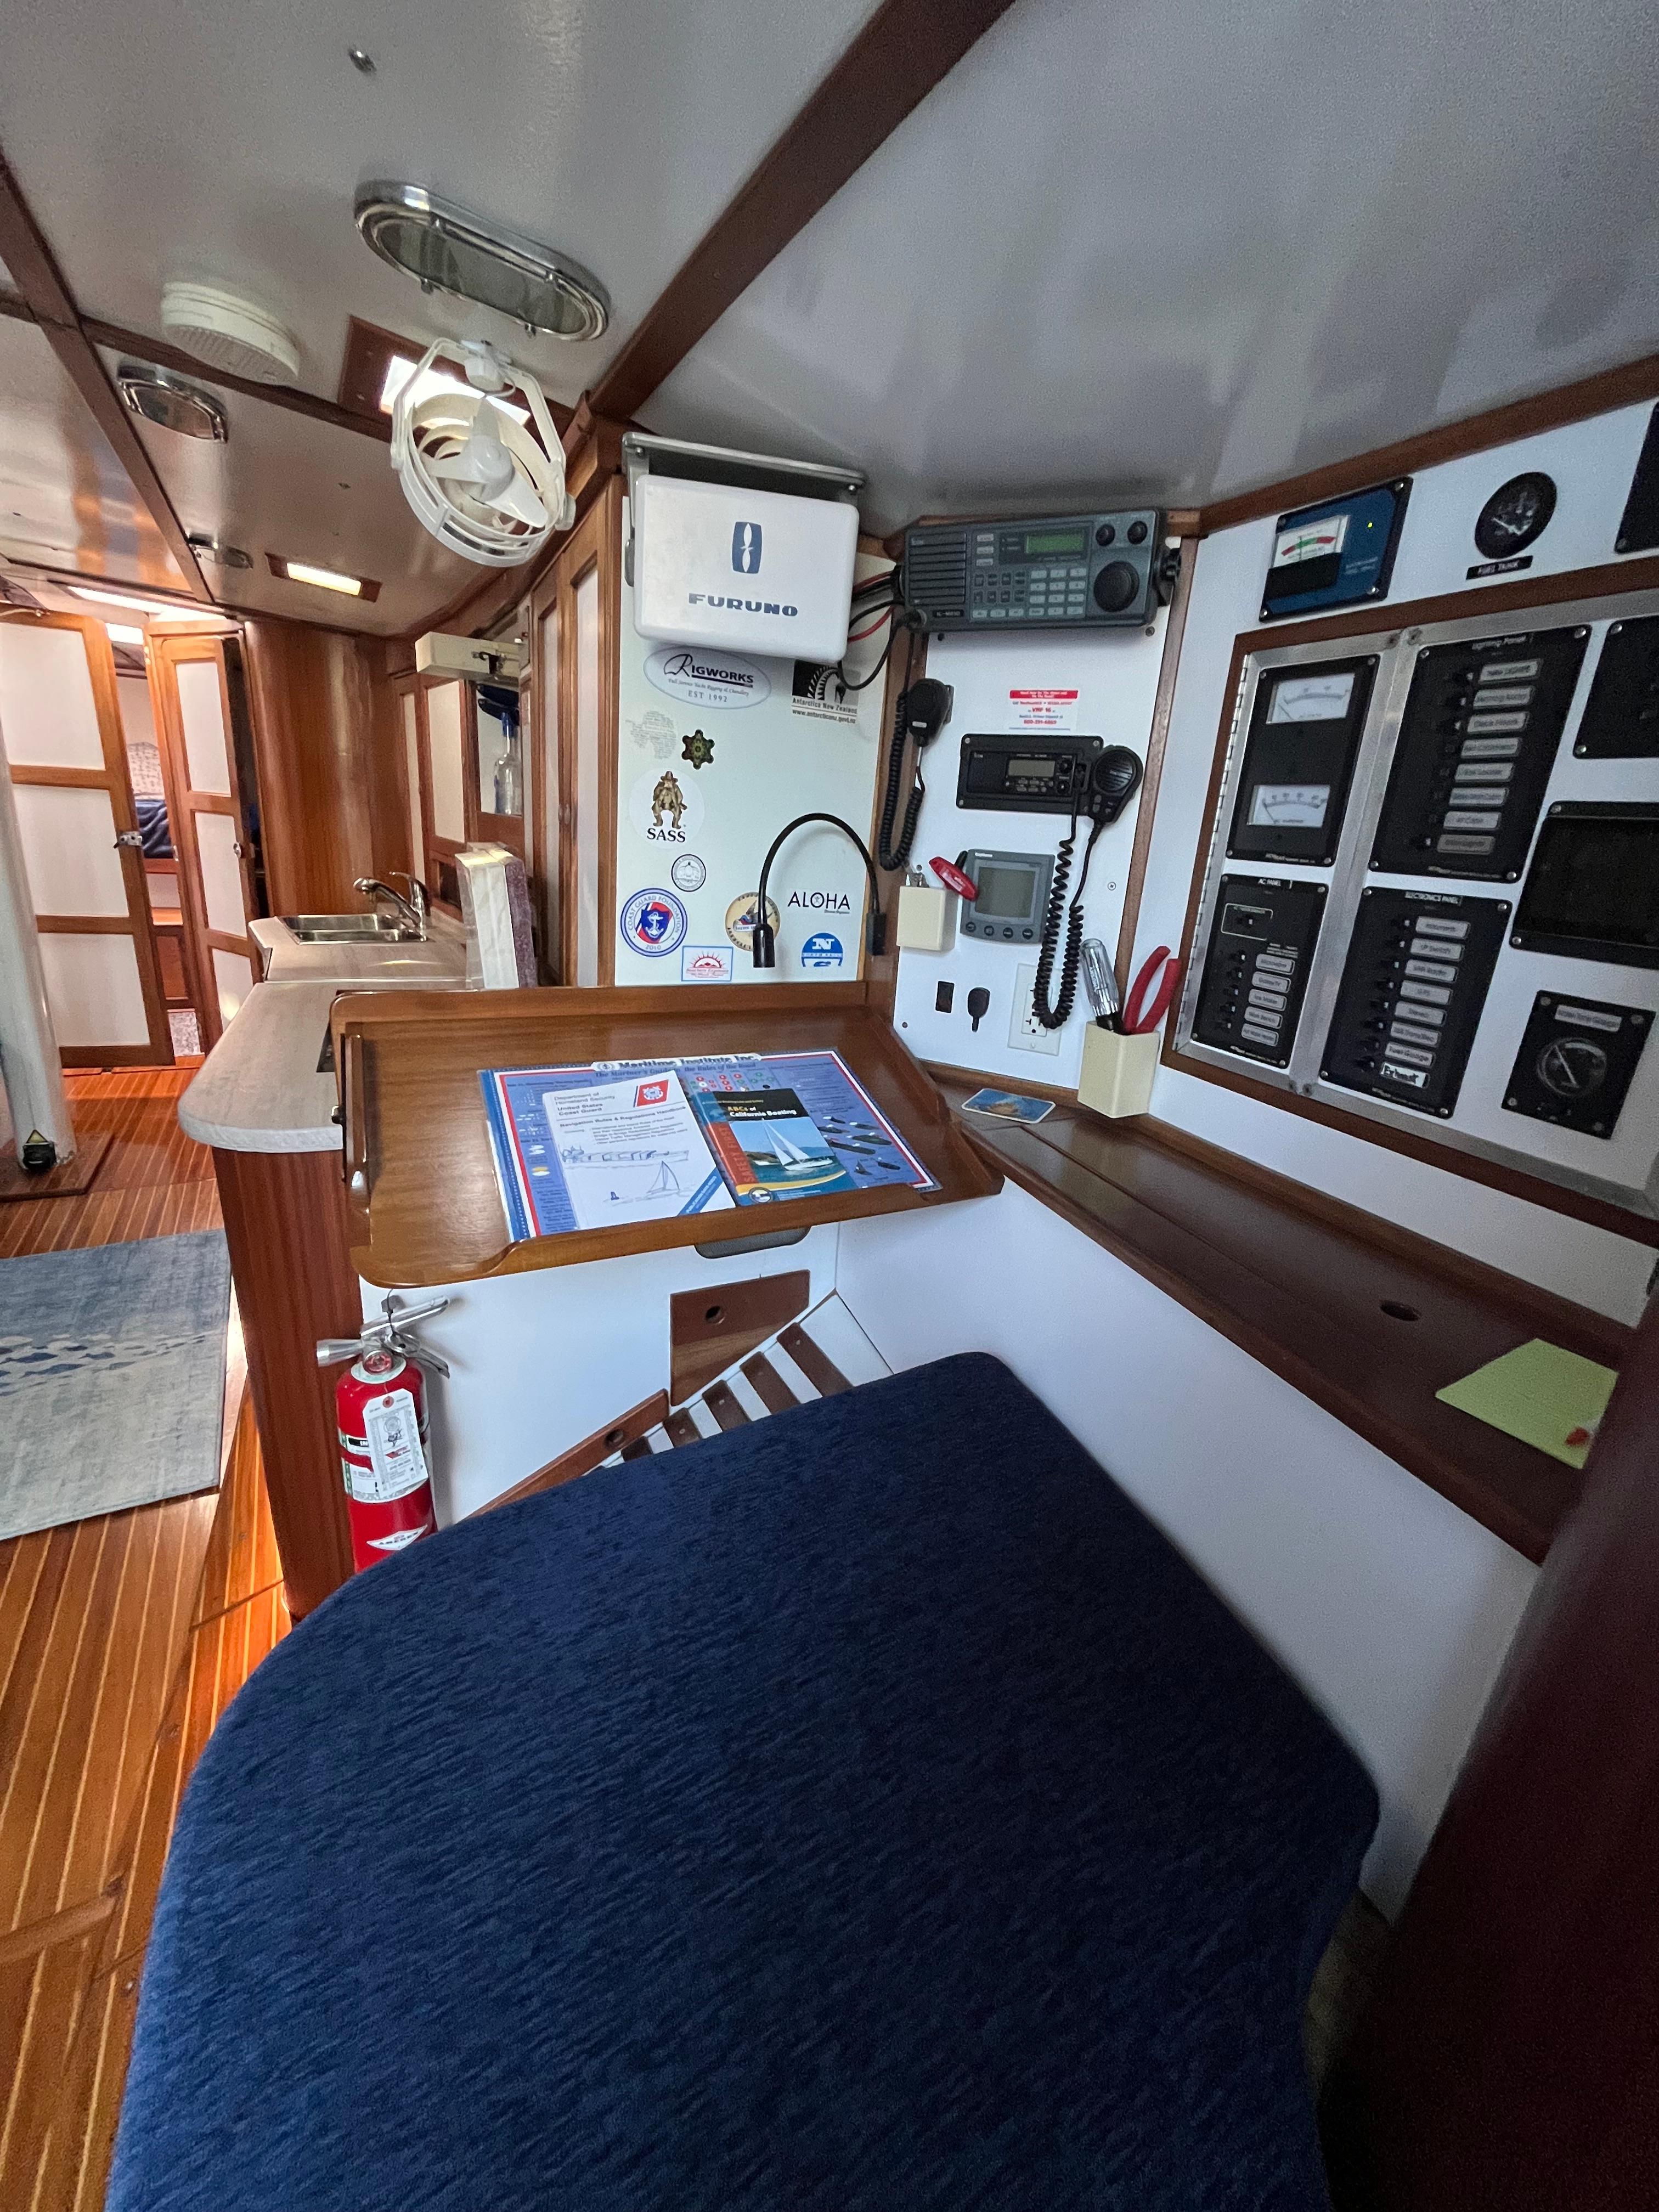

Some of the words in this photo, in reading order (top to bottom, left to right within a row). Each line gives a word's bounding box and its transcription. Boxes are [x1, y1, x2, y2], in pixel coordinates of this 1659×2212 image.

[688, 592, 799, 617] FURUNO
[664, 654, 754, 684] RIGWORKS
[688, 690, 704, 699] EST
[709, 693, 728, 703] 1992
[792, 697, 821, 708] Antarctica
[646, 827, 686, 843] SASS
[787, 890, 851, 910] ALOHA
[627, 908, 636, 931] COAST
[635, 895, 657, 908] GUARD
[658, 896, 681, 933] FOUNDATION
